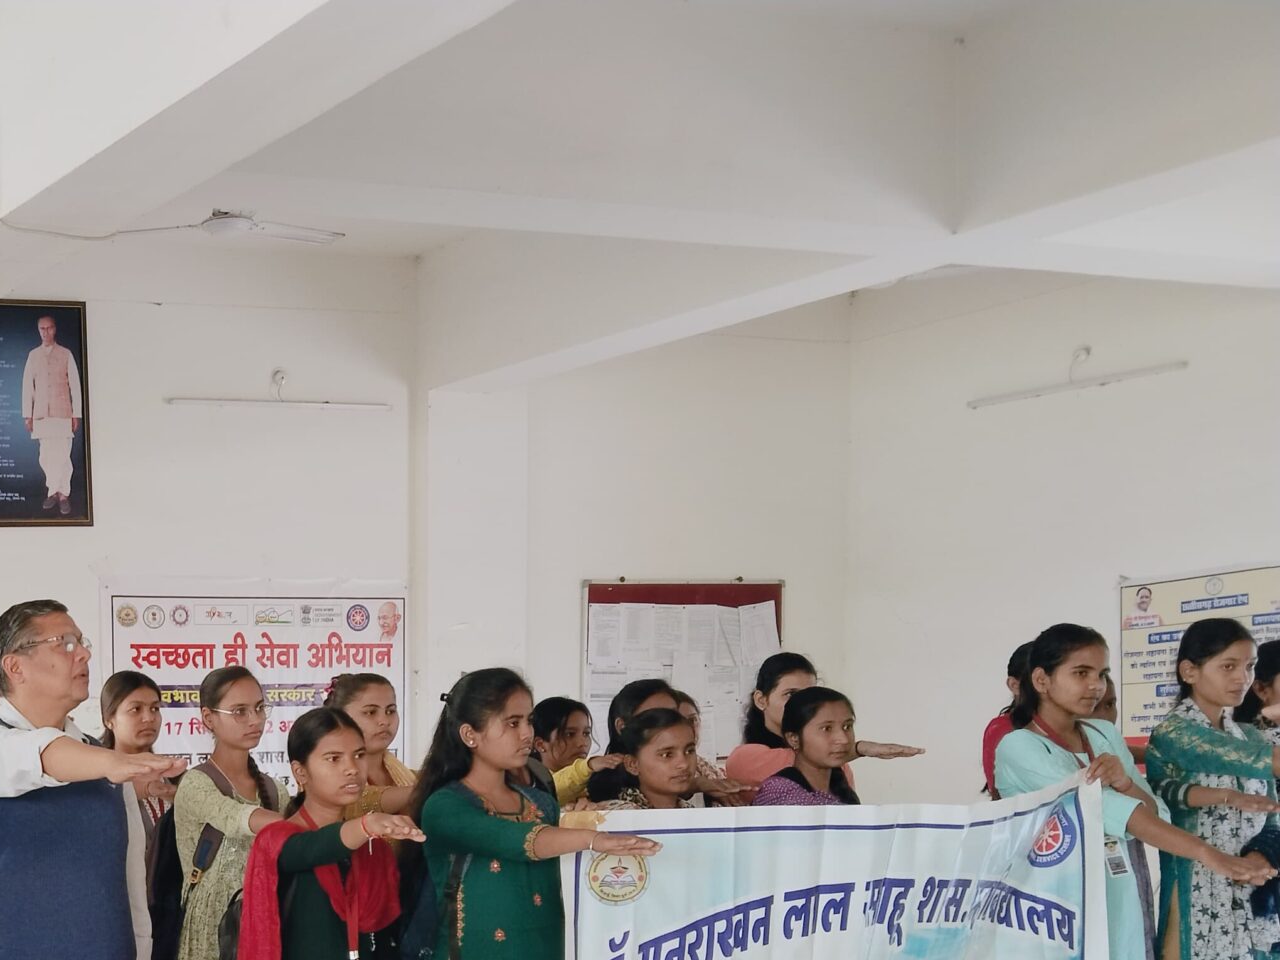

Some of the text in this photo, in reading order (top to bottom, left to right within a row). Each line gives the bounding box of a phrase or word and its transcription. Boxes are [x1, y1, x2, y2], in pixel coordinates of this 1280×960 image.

[130, 632, 393, 669] स्वच्छता ही सेवा अभियान
[160, 689, 200, 704] वभाव
[164, 722, 183, 735] 17
[782, 880, 855, 940] लाल
